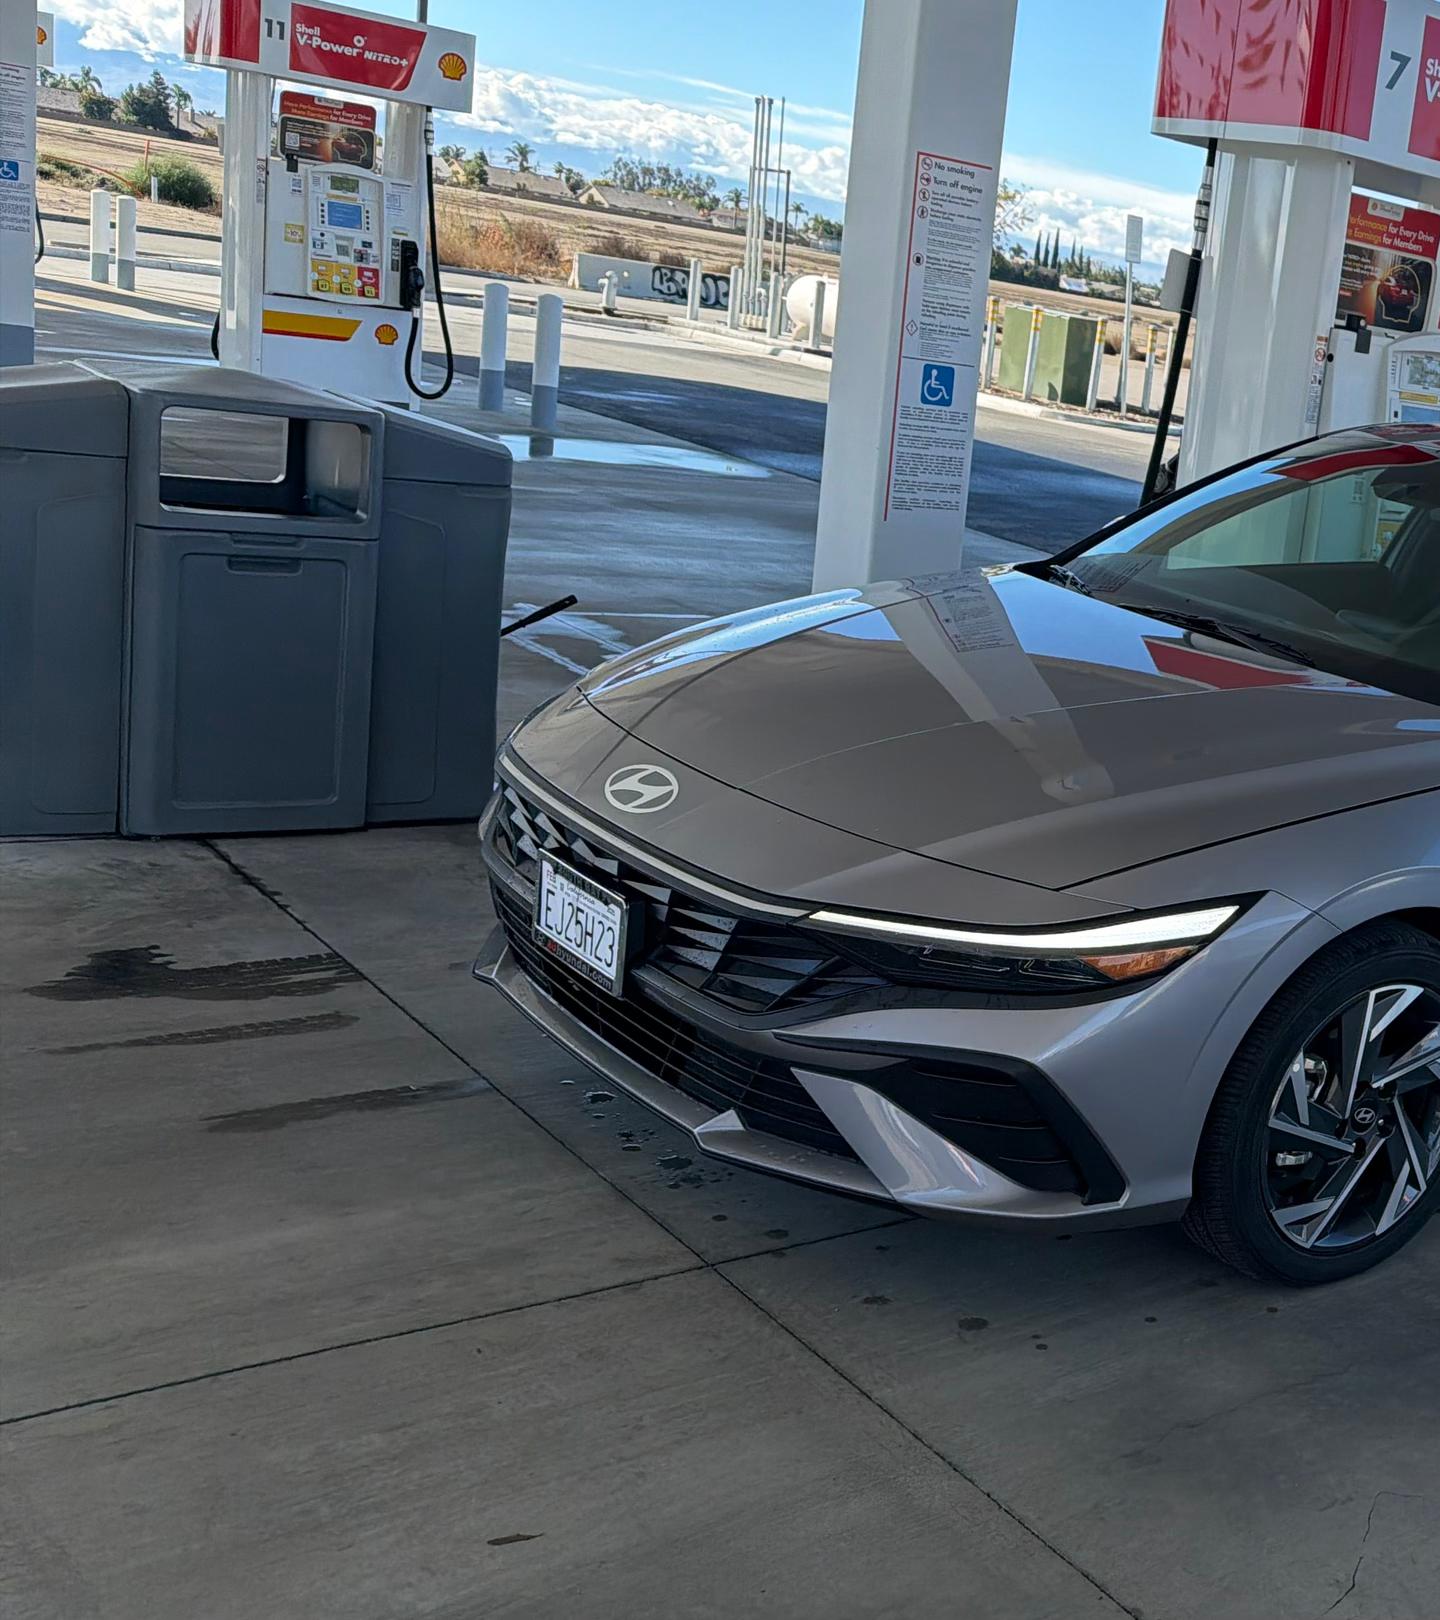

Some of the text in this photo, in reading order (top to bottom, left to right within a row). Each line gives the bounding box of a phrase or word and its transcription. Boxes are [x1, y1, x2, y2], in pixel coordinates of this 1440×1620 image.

[265, 18, 285, 41] 11
[296, 23, 321, 37] Shell
[296, 33, 361, 57] V-Power
[1385, 50, 1412, 90] 7
[934, 162, 975, 178] No smoking
[932, 176, 983, 194] Turn off engine
[1349, 215, 1388, 233] erformance
[1388, 222, 1399, 233] for
[1399, 226, 1420, 240] Every
[1418, 230, 1435, 243] Drive
[1354, 228, 1381, 245] Earnings
[1382, 234, 1393, 245] for
[1393, 237, 1423, 253] Members
[545, 889, 615, 968] EJ25H23
